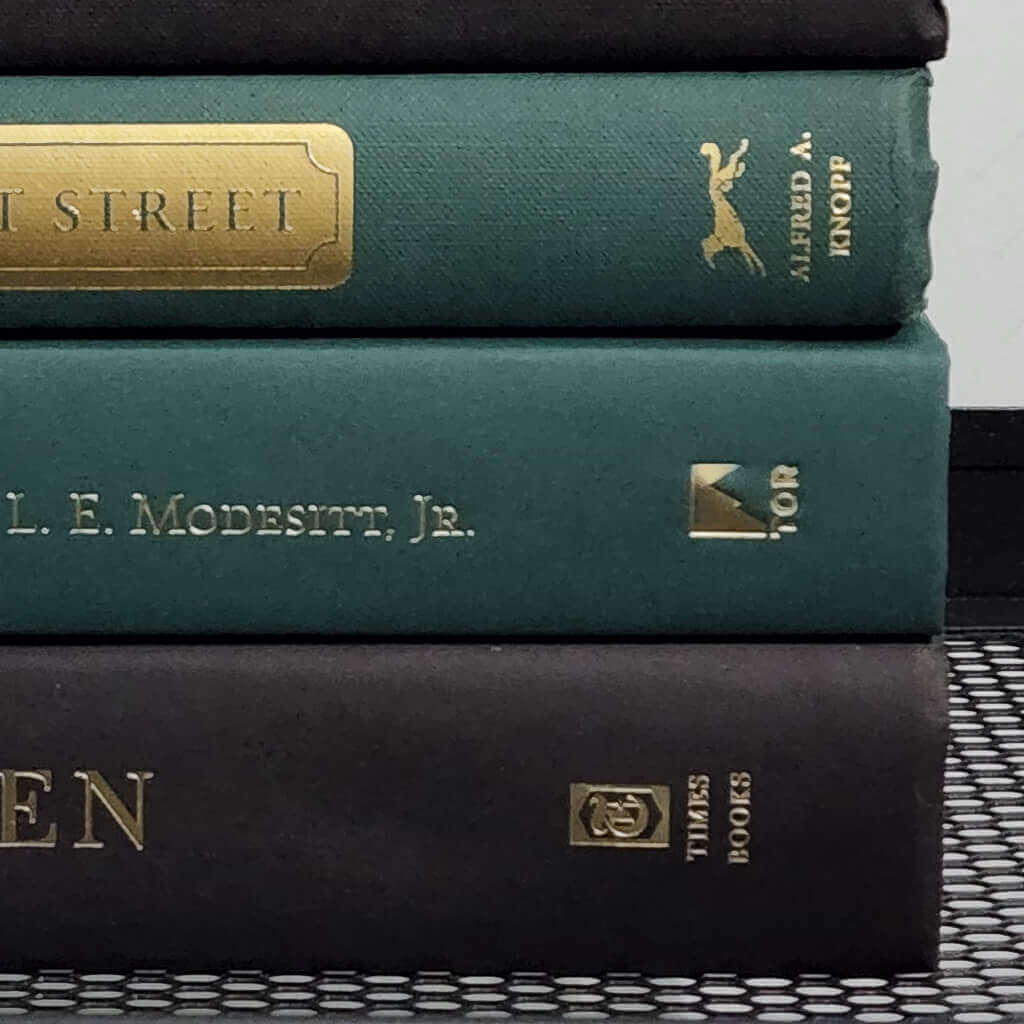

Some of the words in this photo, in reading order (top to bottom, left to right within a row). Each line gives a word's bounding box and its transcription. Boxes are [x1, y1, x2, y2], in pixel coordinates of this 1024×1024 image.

[789, 131, 812, 160] A.
[53, 187, 303, 235] STREET
[790, 170, 812, 282] ALFRED
[829, 155, 852, 257] KNOPF
[6, 491, 50, 536] L.
[69, 492, 113, 536] E.
[770, 464, 800, 539] TOR
[685, 774, 710, 862] TIMES
[728, 772, 752, 864] BOOKS
